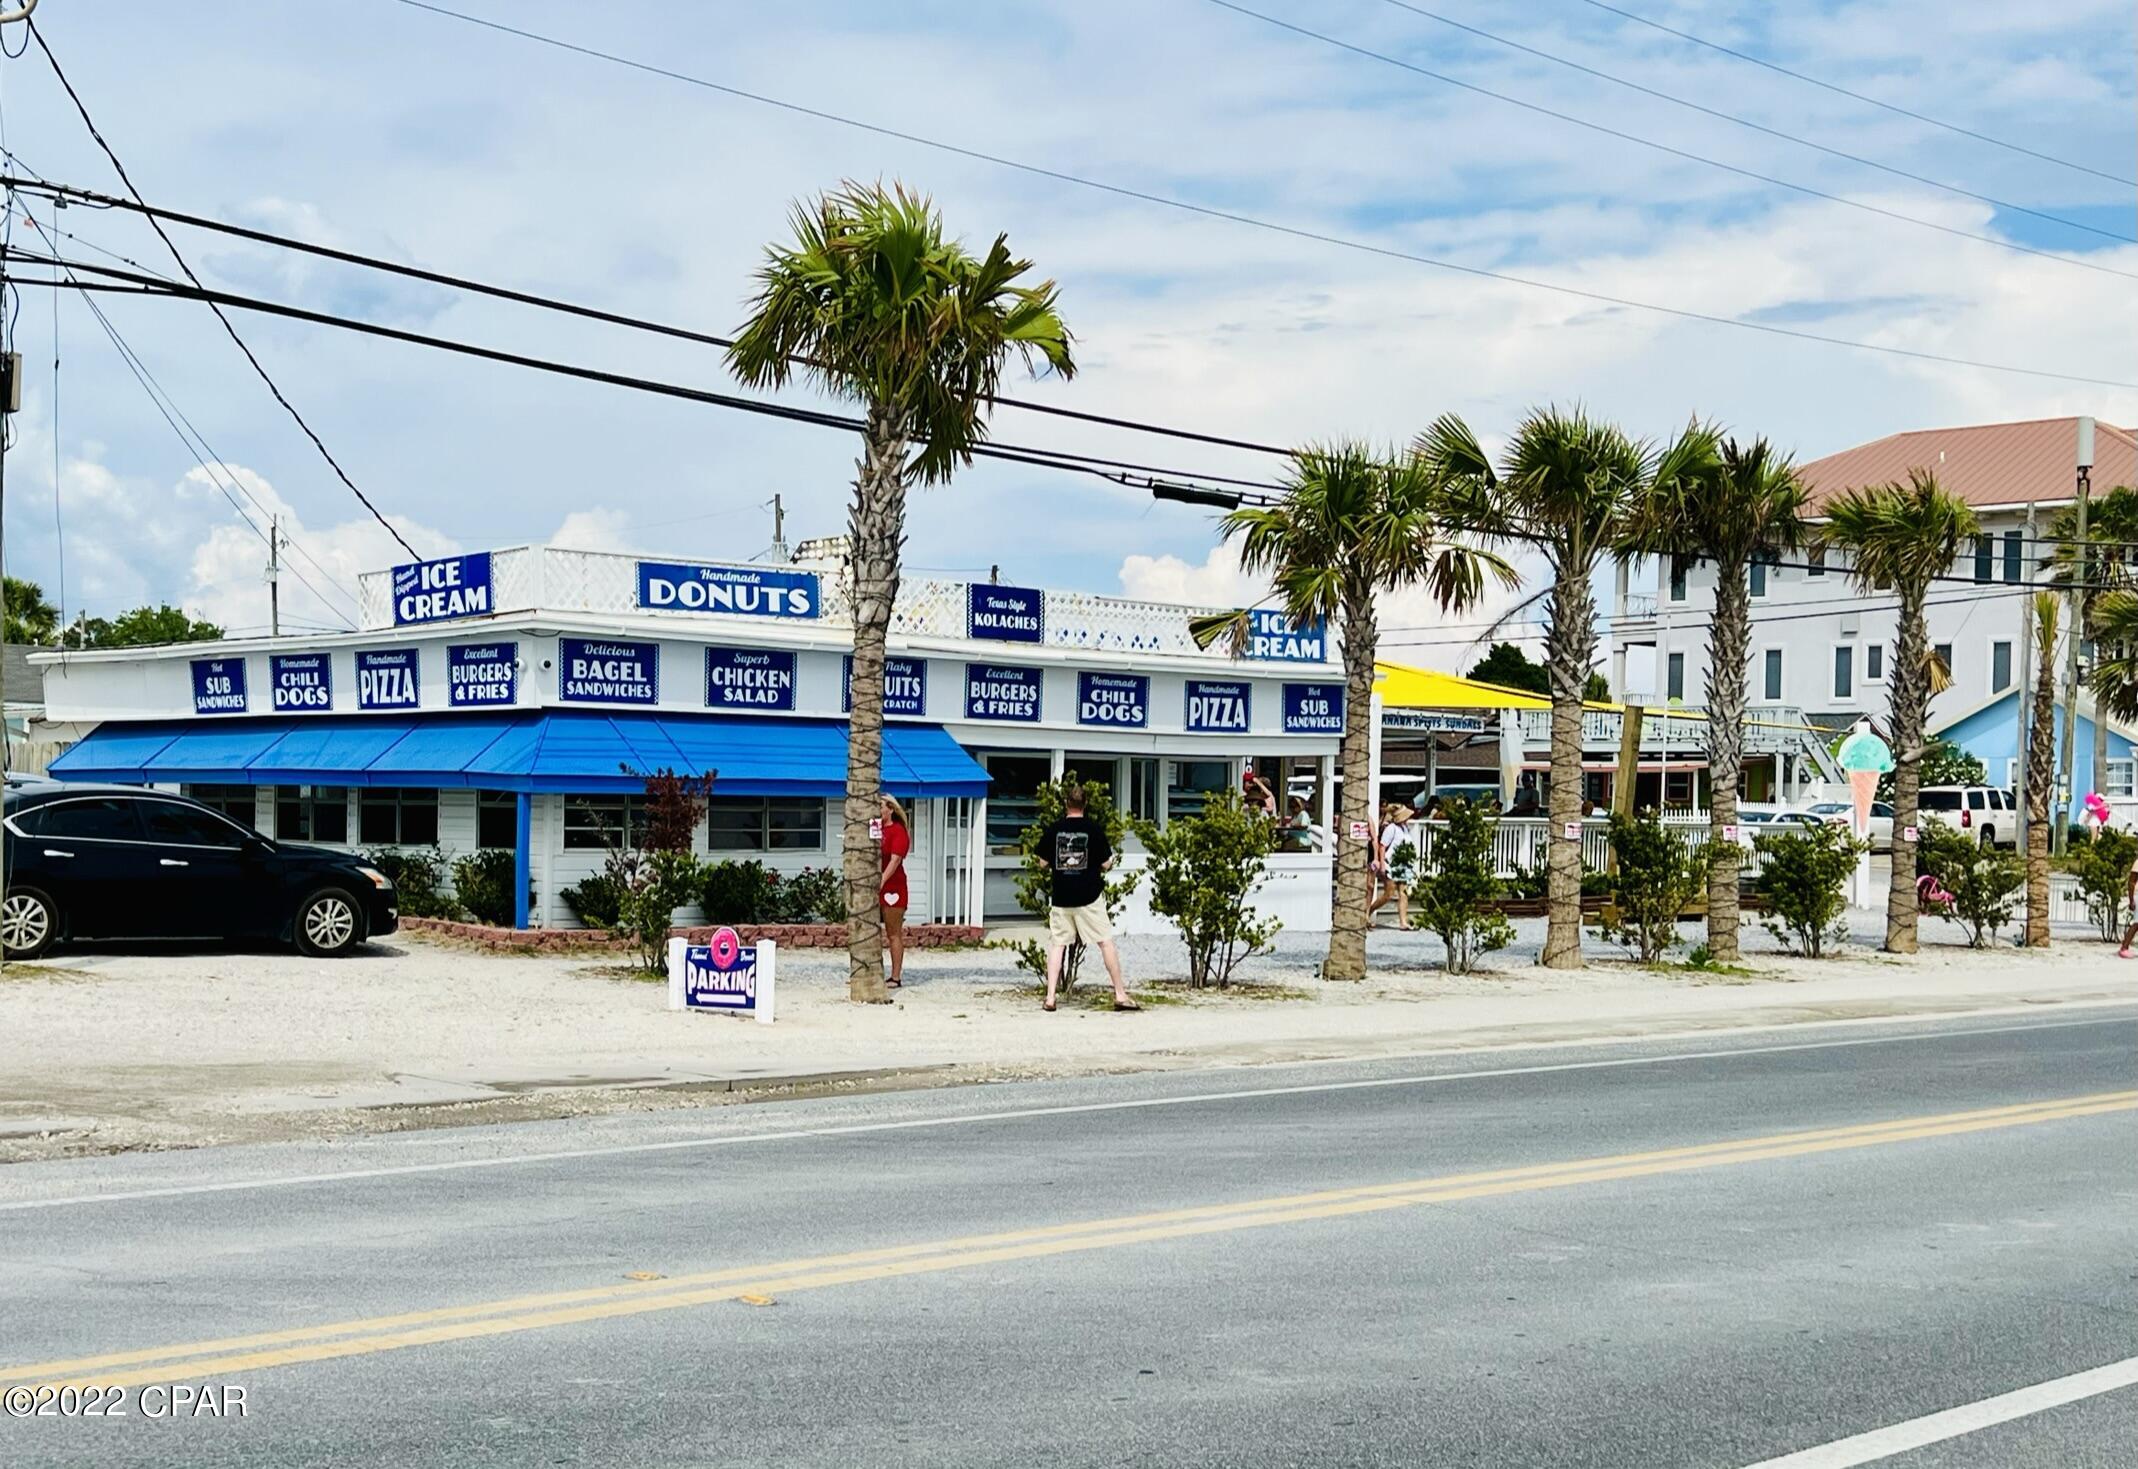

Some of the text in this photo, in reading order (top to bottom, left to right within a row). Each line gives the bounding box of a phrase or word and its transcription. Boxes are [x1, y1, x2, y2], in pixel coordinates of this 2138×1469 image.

[421, 561, 461, 590] ICE
[700, 569, 761, 584] Handmade
[395, 575, 419, 596] Dipped
[400, 585, 487, 621] CREAM
[649, 578, 810, 614] DONUTS
[986, 597, 1026, 613] Texas Style
[974, 613, 1038, 631] KOLACHES
[464, 648, 498, 660] Excellent
[584, 644, 635, 657] Delicious
[281, 659, 319, 669] Homemade
[366, 654, 406, 665] Handmade
[733, 653, 769, 666] Superb
[452, 662, 512, 684] BURGERS
[573, 659, 647, 682] BAGEL
[712, 666, 790, 688] CHICKEN
[986, 668, 1023, 680] Excellent
[206, 677, 231, 694] SUB
[281, 672, 319, 687] CHILI
[360, 668, 416, 704] PIZZA
[1091, 676, 1137, 688] Homemade
[275, 687, 328, 706] DOGS
[455, 684, 509, 700] & FRIES
[567, 681, 652, 698] SANDWICHES
[724, 687, 778, 703] SALAD
[970, 681, 1037, 702] BURGERS
[1090, 689, 1135, 704] CHILI
[1198, 684, 1240, 695] Handmade
[197, 694, 245, 709] SANDWICHES
[884, 700, 918, 709] CRATCH
[973, 700, 1033, 716] & FRIES
[1300, 699, 1329, 715] SUB
[1081, 702, 1143, 723] DOGS
[1189, 697, 1246, 728] PIZZA
[1382, 714, 1411, 726] ANANA
[1286, 716, 1341, 728] SANDWICHES
[687, 960, 755, 998] PARKING
